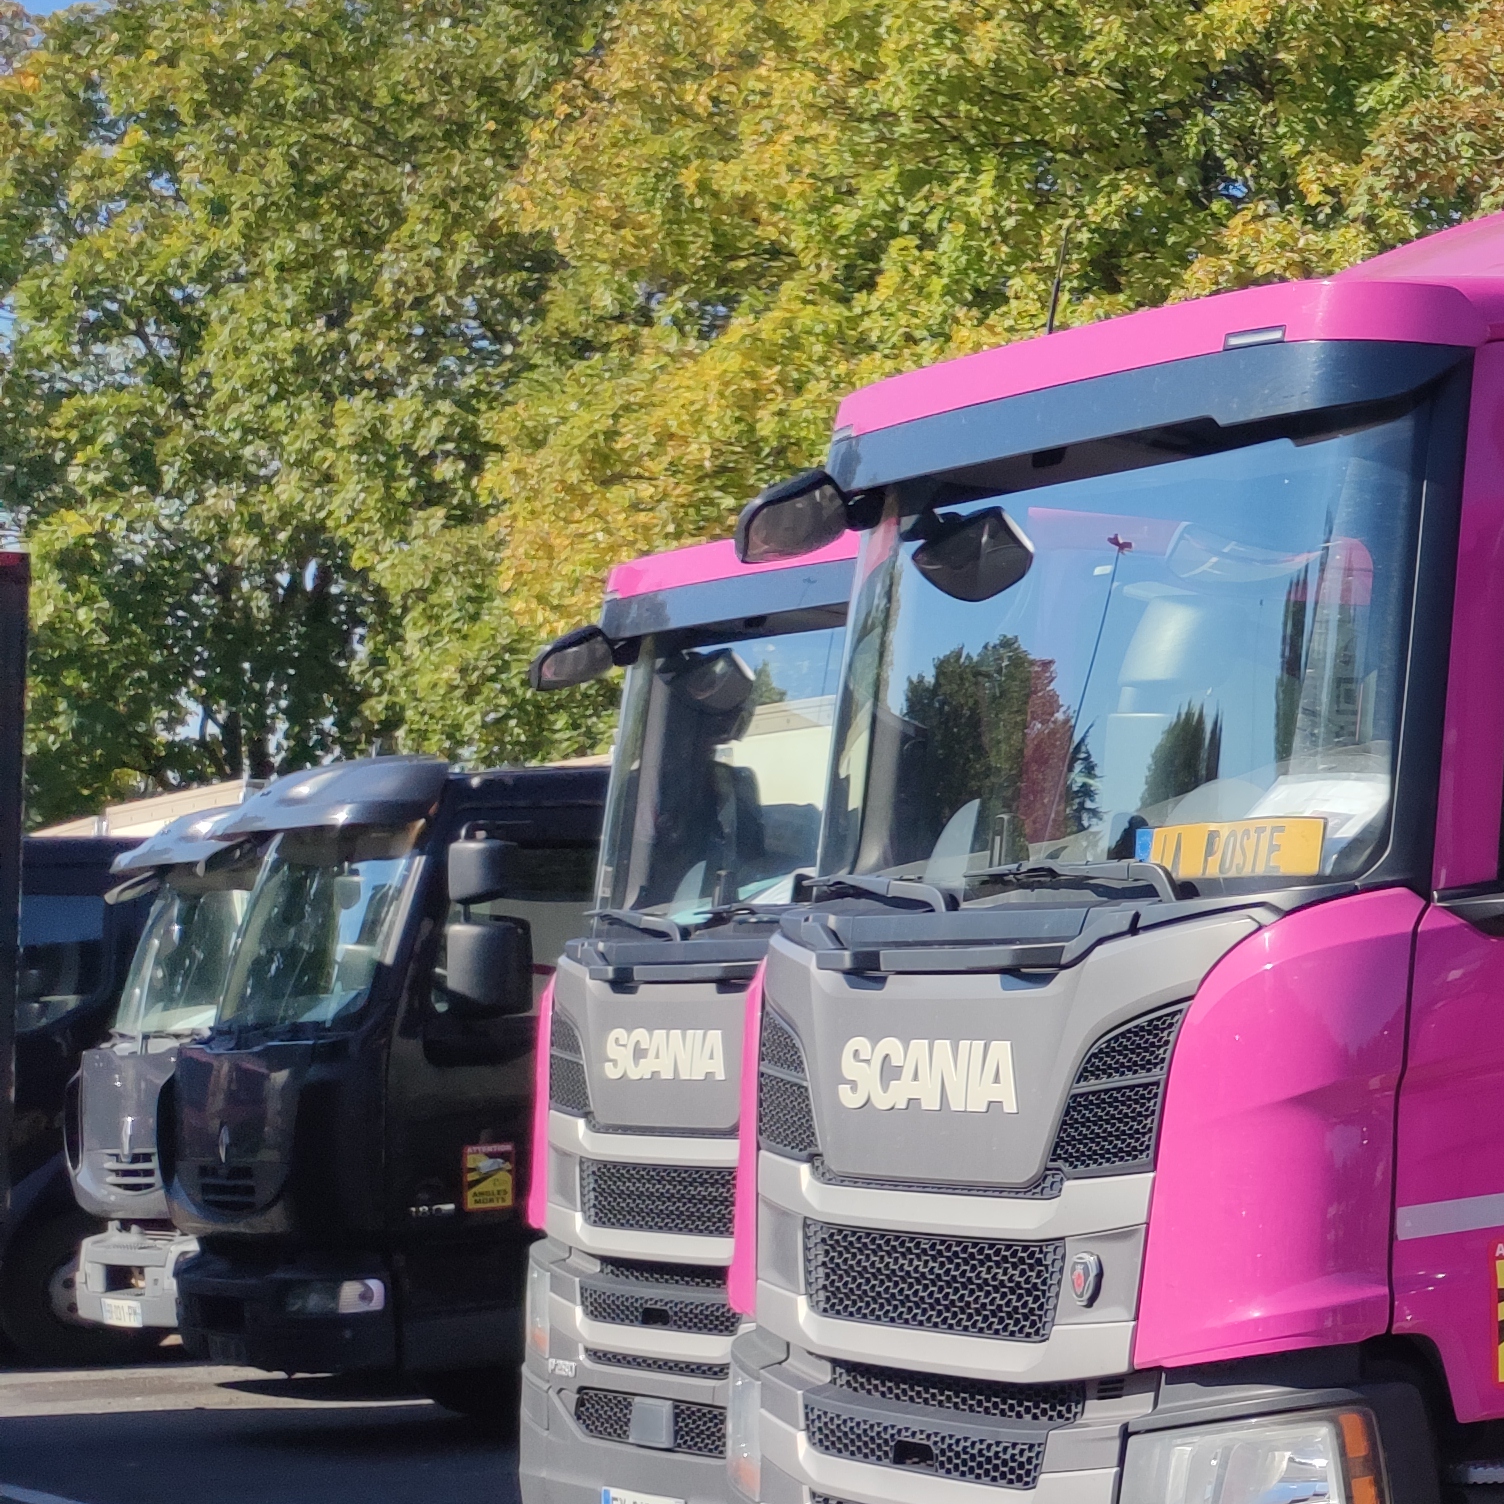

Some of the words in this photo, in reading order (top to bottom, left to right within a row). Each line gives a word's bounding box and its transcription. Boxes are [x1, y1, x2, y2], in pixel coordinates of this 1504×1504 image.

[1202, 825, 1286, 877] POSTE
[604, 1027, 726, 1081] SCANIA
[838, 1036, 1020, 1115] SCANIA
